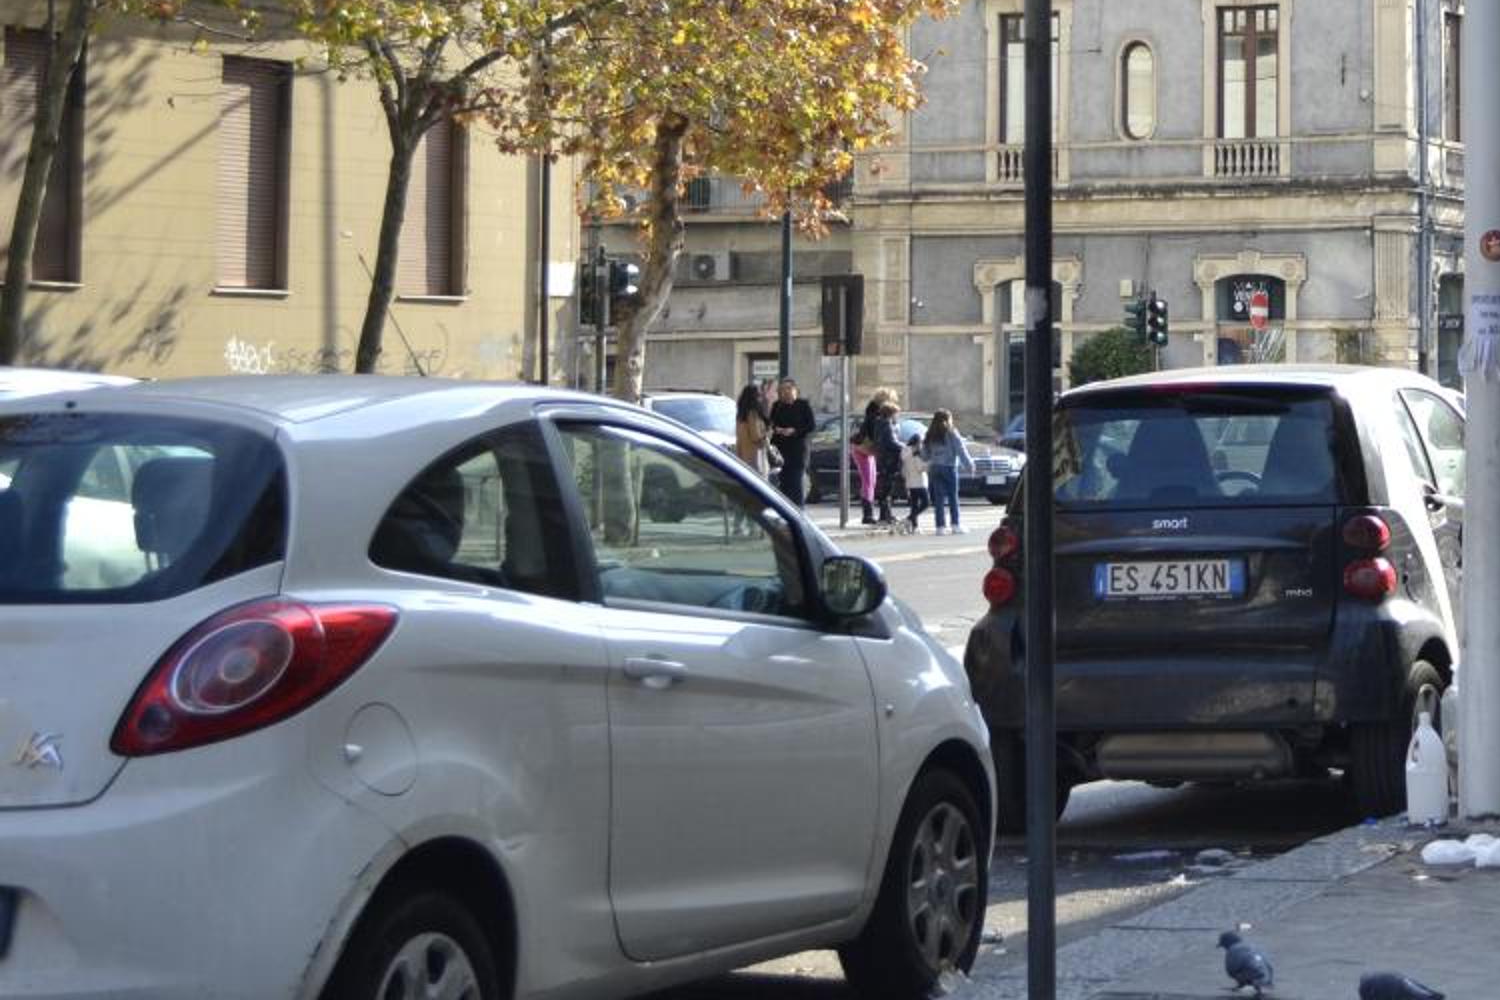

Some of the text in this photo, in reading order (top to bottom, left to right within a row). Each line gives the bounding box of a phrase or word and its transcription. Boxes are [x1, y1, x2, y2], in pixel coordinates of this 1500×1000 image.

[1151, 517, 1188, 529] smart
[1110, 563, 1227, 593] ES 451KN
